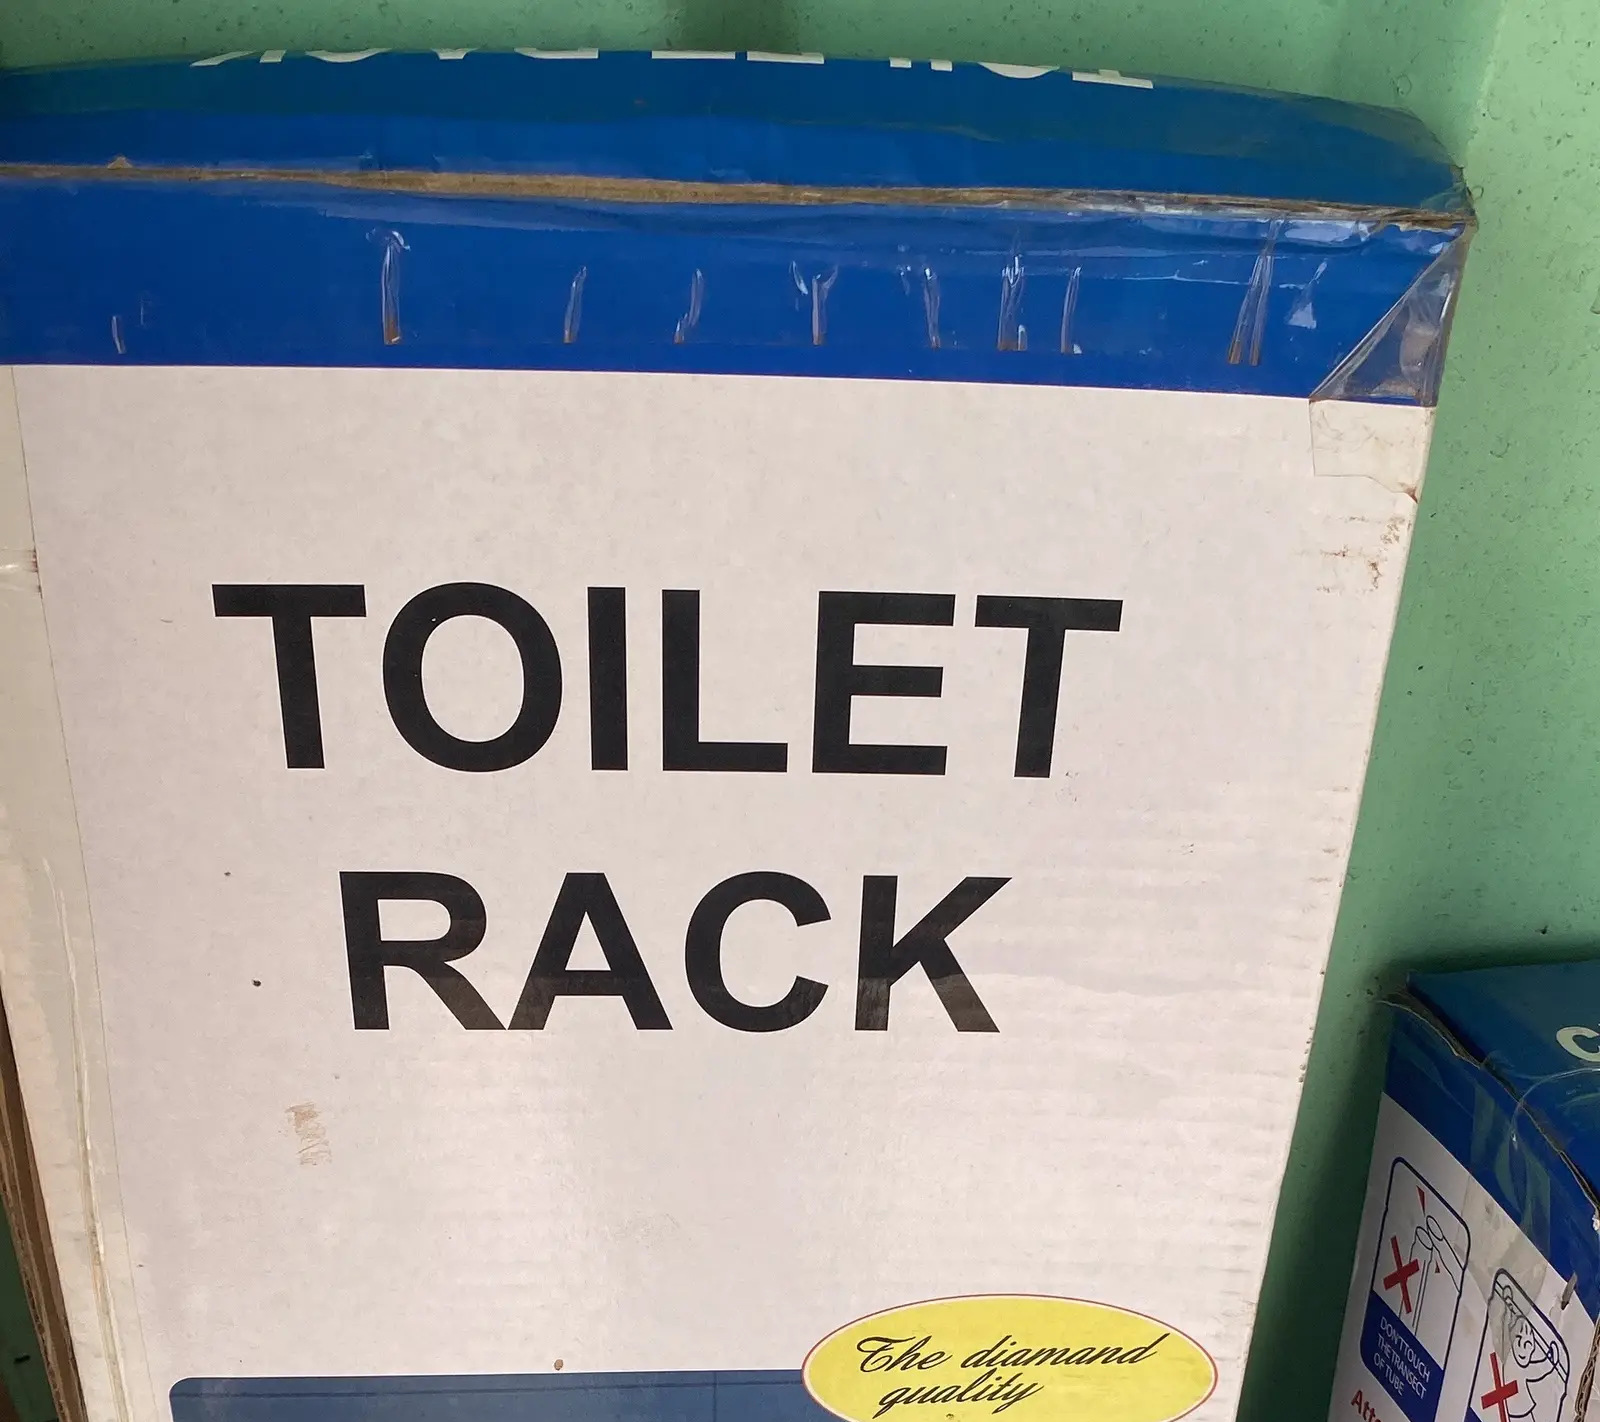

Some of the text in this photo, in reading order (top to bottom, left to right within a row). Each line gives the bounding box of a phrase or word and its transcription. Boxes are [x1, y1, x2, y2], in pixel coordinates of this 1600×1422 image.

[211, 581, 1124, 779] TOILET
[339, 870, 1013, 1034] RACK
[856, 1332, 1172, 1374] The diamand
[1377, 1332, 1391, 1359] THE
[1404, 1342, 1431, 1383] TOUCH
[872, 1367, 1045, 1420] quality
[1373, 1352, 1405, 1396] OF TUBE
